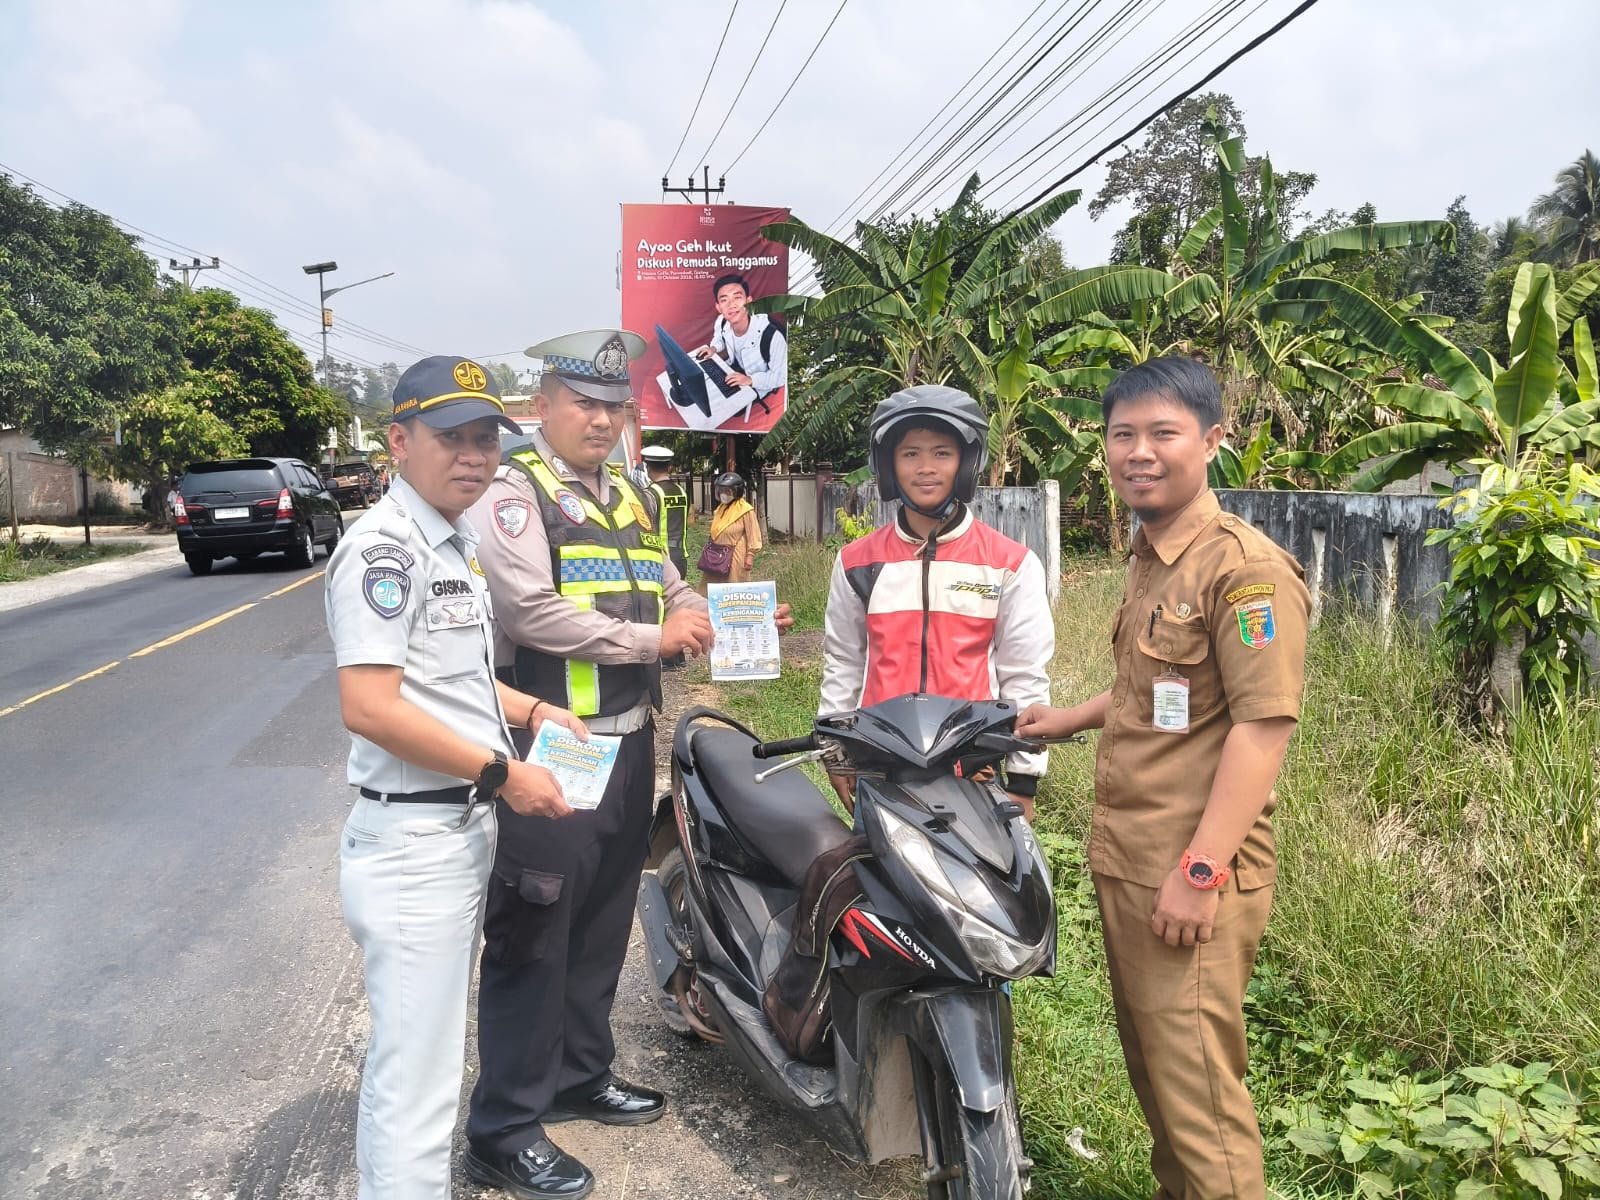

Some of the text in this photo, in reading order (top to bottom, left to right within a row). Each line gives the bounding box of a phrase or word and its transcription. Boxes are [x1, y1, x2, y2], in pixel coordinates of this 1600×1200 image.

[637, 239, 732, 256] Ayoo Geh Ikut
[637, 255, 778, 270] Diskusi Pemuda Tanggamus
[369, 571, 385, 579] JASA
[723, 592, 761, 601] DISKON
[556, 736, 600, 753] DISKON
[895, 926, 937, 970] HONDA
